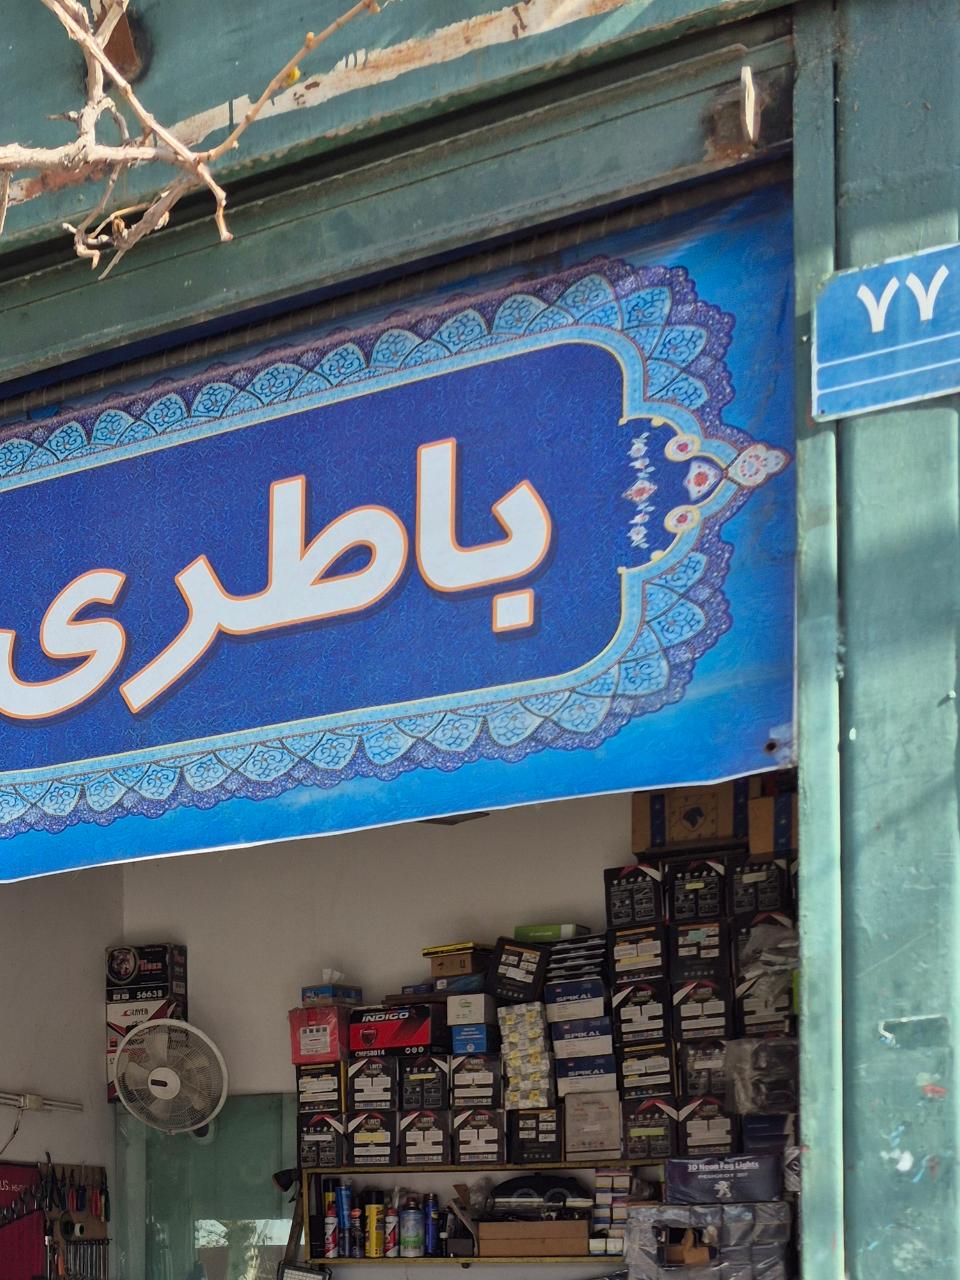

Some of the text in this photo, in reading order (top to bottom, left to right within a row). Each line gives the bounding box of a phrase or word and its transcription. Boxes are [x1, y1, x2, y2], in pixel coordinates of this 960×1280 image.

[856, 264, 950, 333] ۷۷
[361, 1011, 410, 1023] INDIGO
[564, 1030, 600, 1039] SPIKAL
[568, 1067, 606, 1077] SPIKAL
